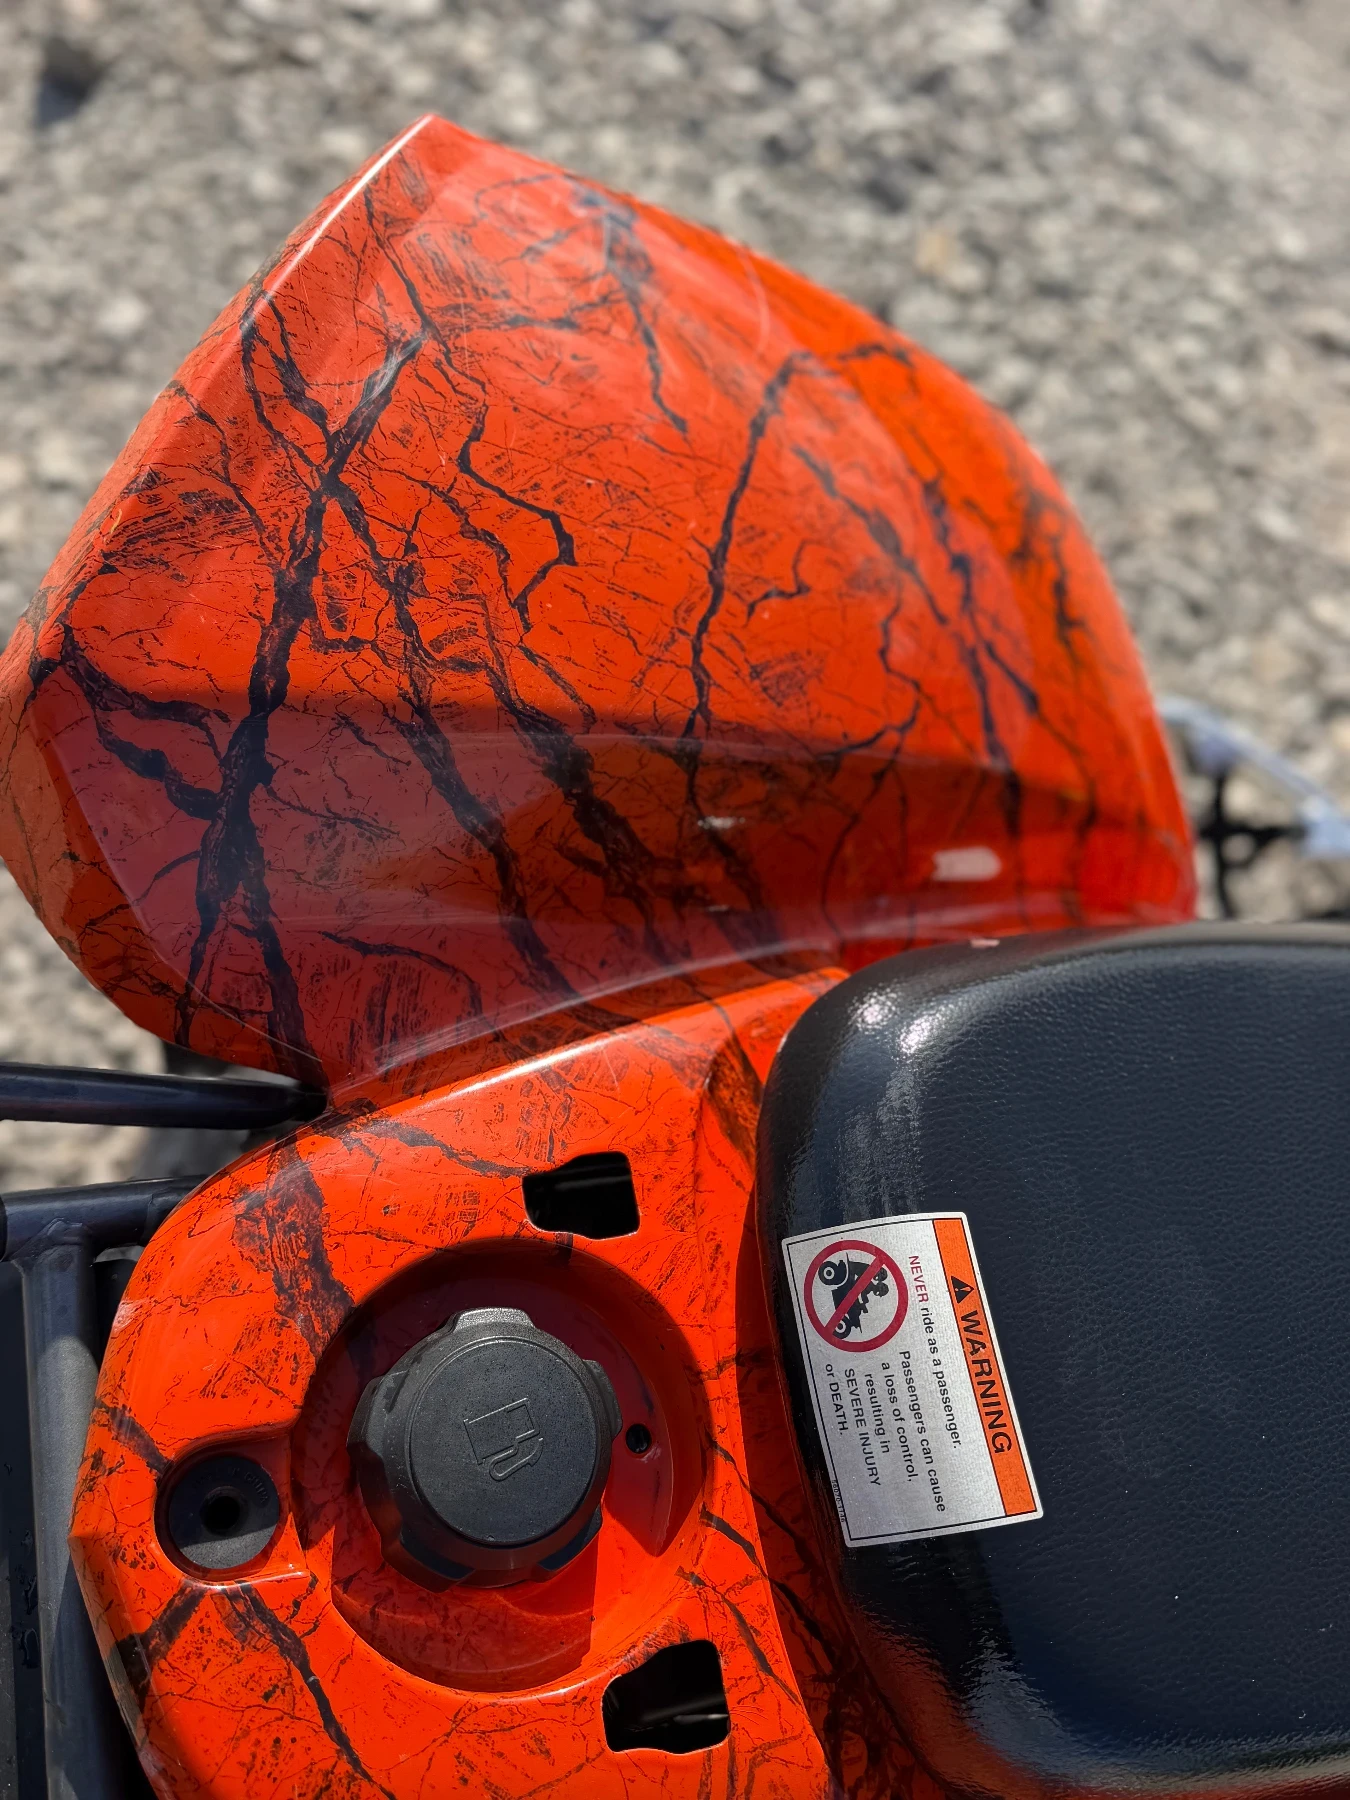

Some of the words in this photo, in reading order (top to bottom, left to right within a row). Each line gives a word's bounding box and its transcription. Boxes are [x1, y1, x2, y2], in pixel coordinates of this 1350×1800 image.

[908, 1255, 929, 1303] NEVER
[920, 1307, 934, 1334] ride
[825, 1364, 834, 1377] or
[882, 1362, 890, 1370] a
[928, 1338, 939, 1355] as
[933, 1359, 941, 1367] a
[884, 1374, 898, 1404] loss
[961, 1310, 1012, 1454] WARNING
[829, 1383, 848, 1435] DEATH.
[844, 1368, 867, 1428] SEVERE
[859, 1431, 881, 1486] INJURY
[864, 1373, 885, 1436] resulting
[879, 1440, 890, 1453] in
[892, 1409, 905, 1423] of
[899, 1351, 926, 1434] Passengers
[920, 1439, 934, 1464] can
[928, 1469, 946, 1512] cause
[933, 1370, 962, 1449] passenger.
[897, 1427, 918, 1482] control,
